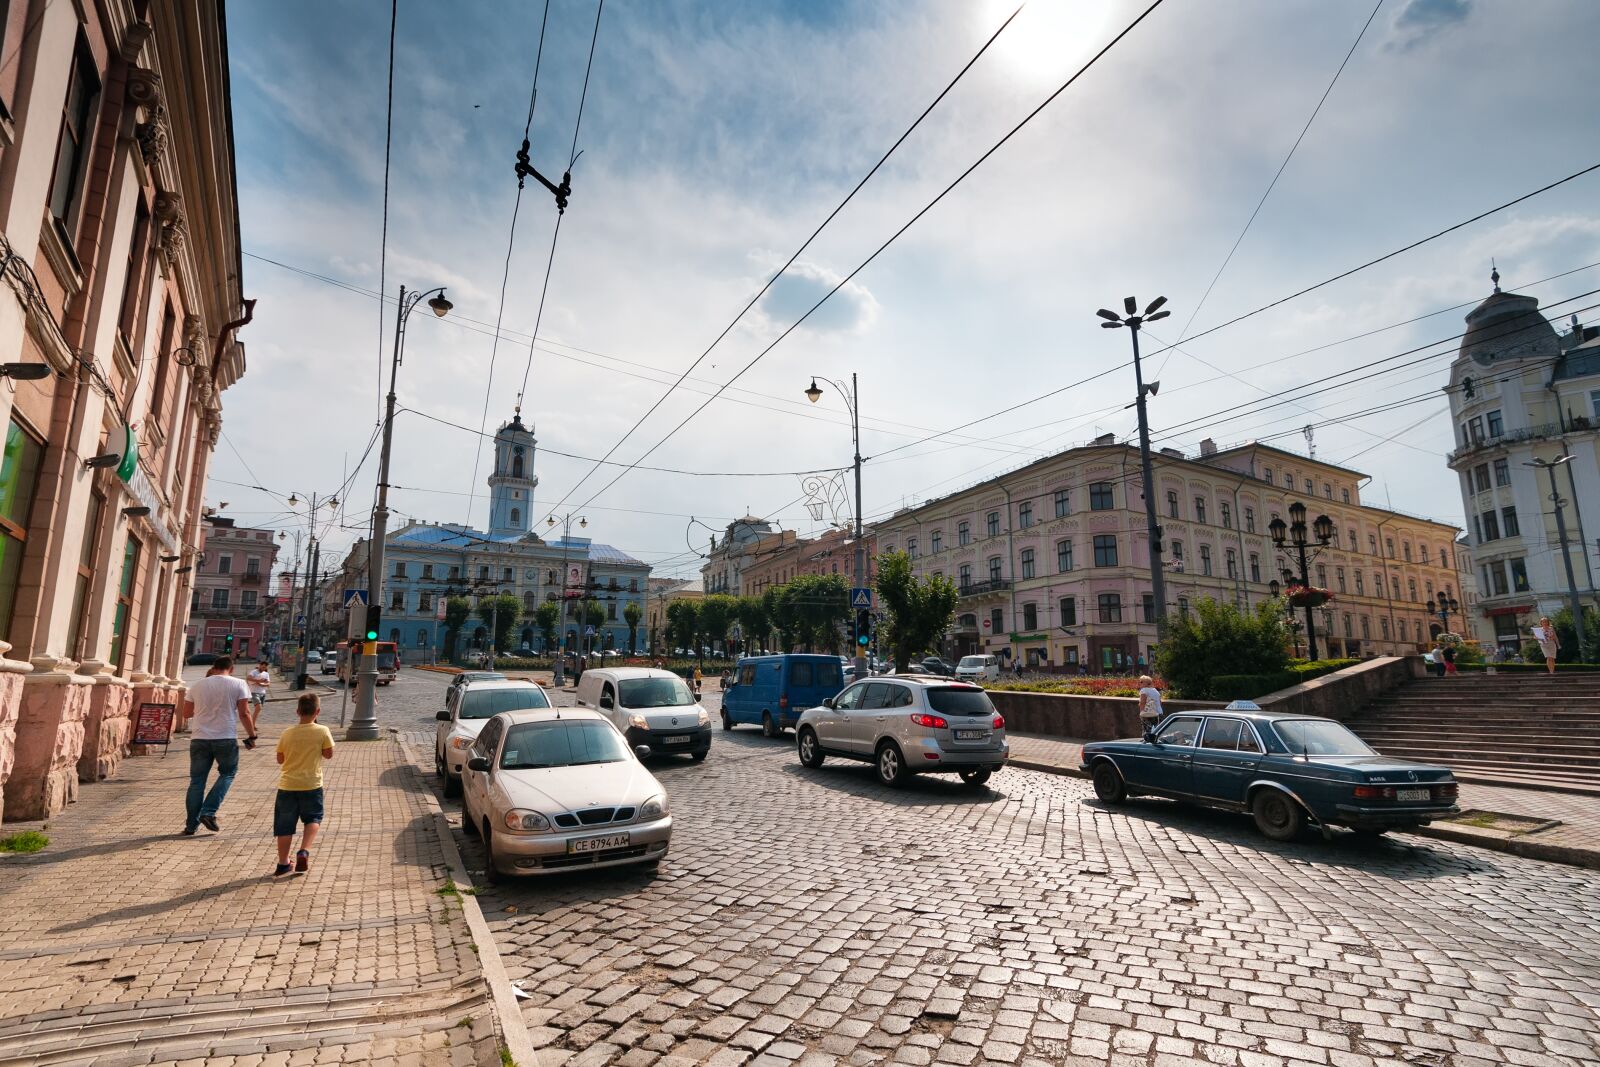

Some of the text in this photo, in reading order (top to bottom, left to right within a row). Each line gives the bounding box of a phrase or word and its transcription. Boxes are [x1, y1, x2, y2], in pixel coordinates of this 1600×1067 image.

[575, 836, 627, 851] CE 8794 AA
